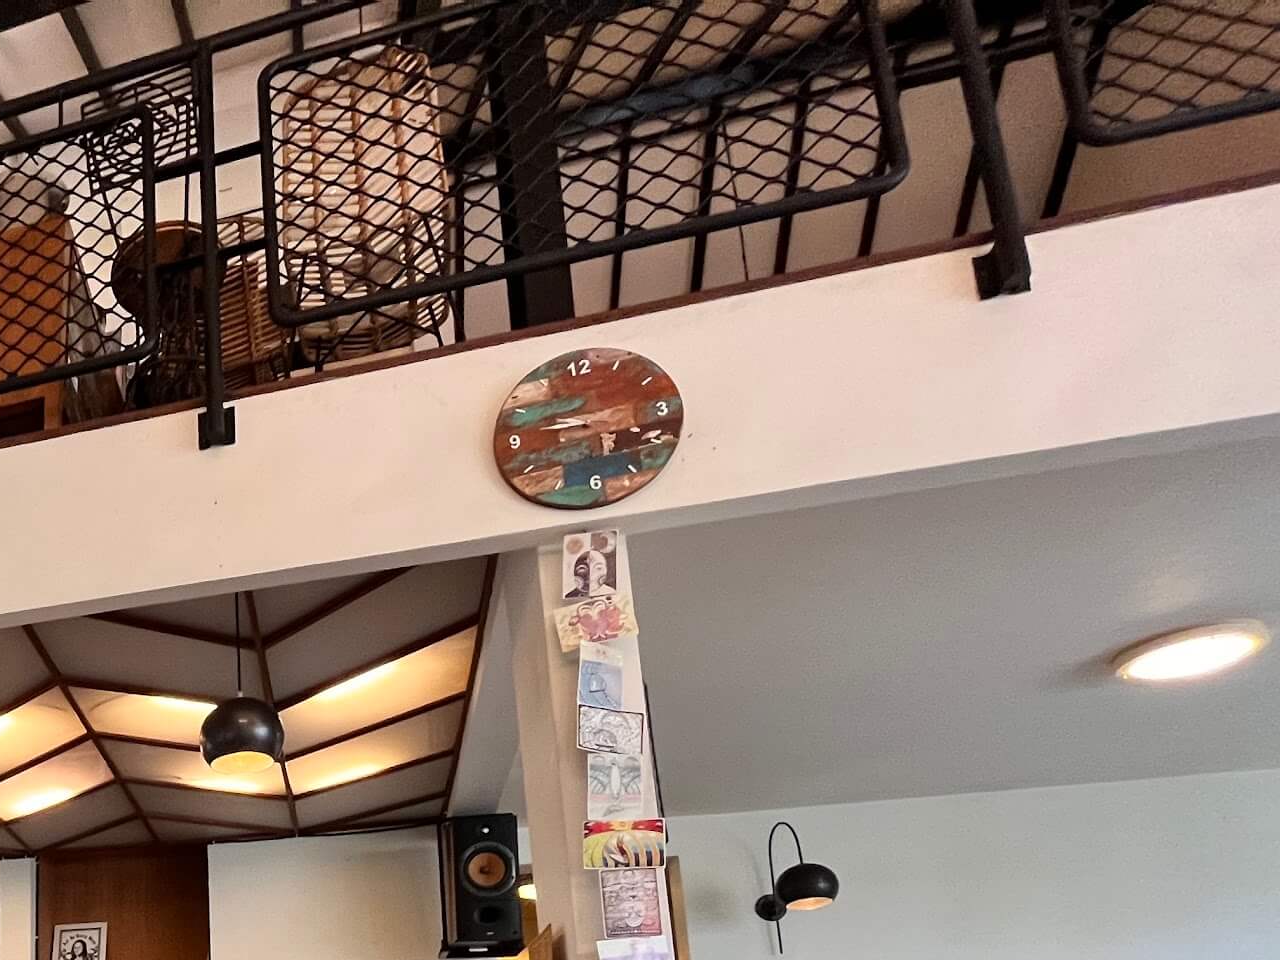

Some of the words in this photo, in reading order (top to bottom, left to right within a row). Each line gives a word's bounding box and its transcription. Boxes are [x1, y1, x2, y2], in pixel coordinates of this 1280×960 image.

[567, 359, 591, 377] 12
[655, 401, 668, 416] 3
[509, 435, 521, 449] 9
[589, 475, 602, 490] 6
